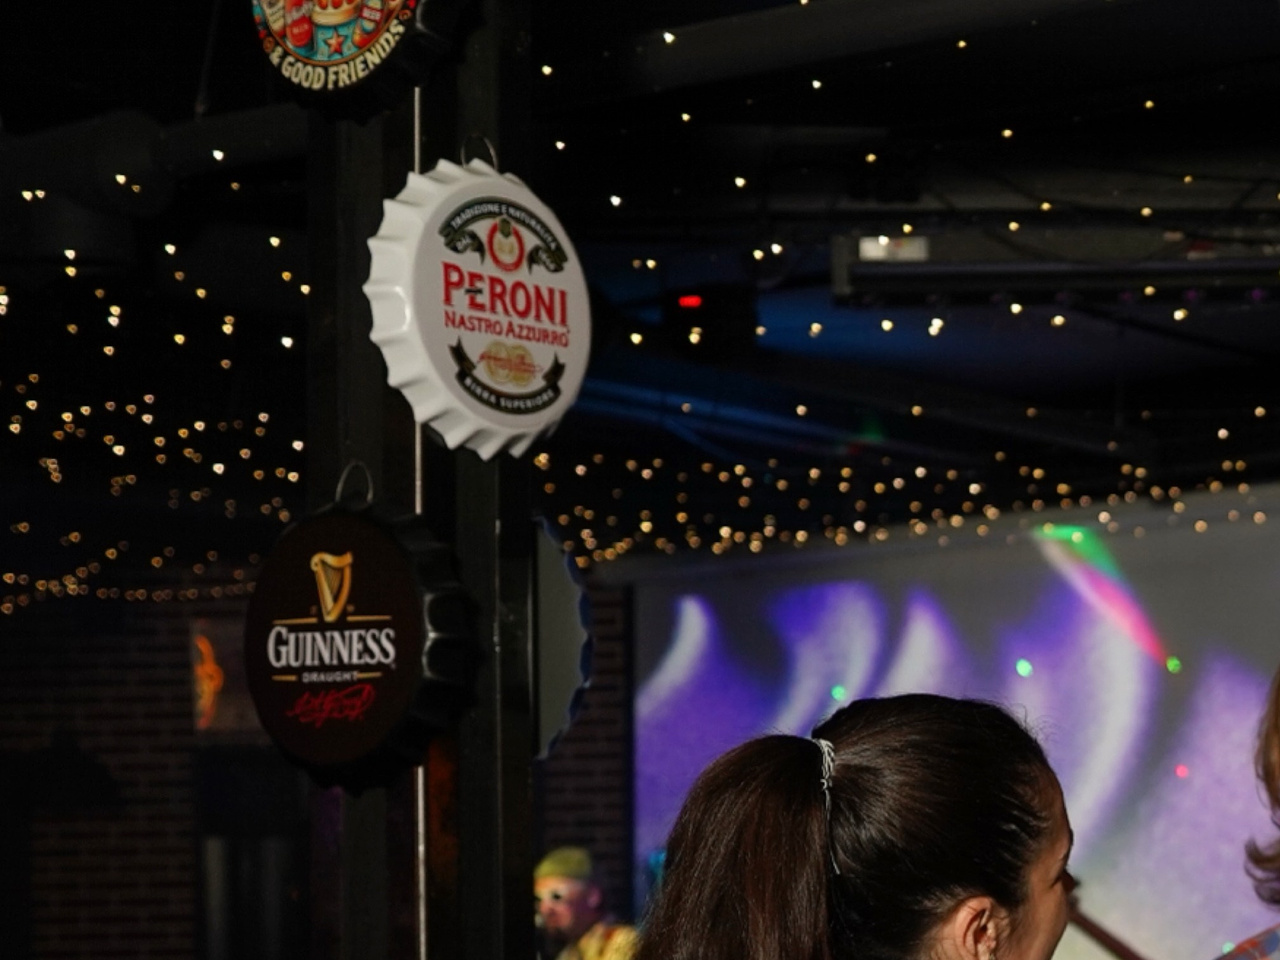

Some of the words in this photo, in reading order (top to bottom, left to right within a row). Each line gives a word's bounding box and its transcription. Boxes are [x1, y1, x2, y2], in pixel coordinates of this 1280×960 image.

[282, 63, 325, 90] GOOD
[328, 19, 405, 89] FRIENDS
[441, 261, 568, 327] PERONI
[444, 310, 501, 335] NASTRO
[505, 320, 569, 347] AZZURRO
[267, 625, 396, 668] GUINNESS
[302, 671, 358, 683] DRAUGHT
